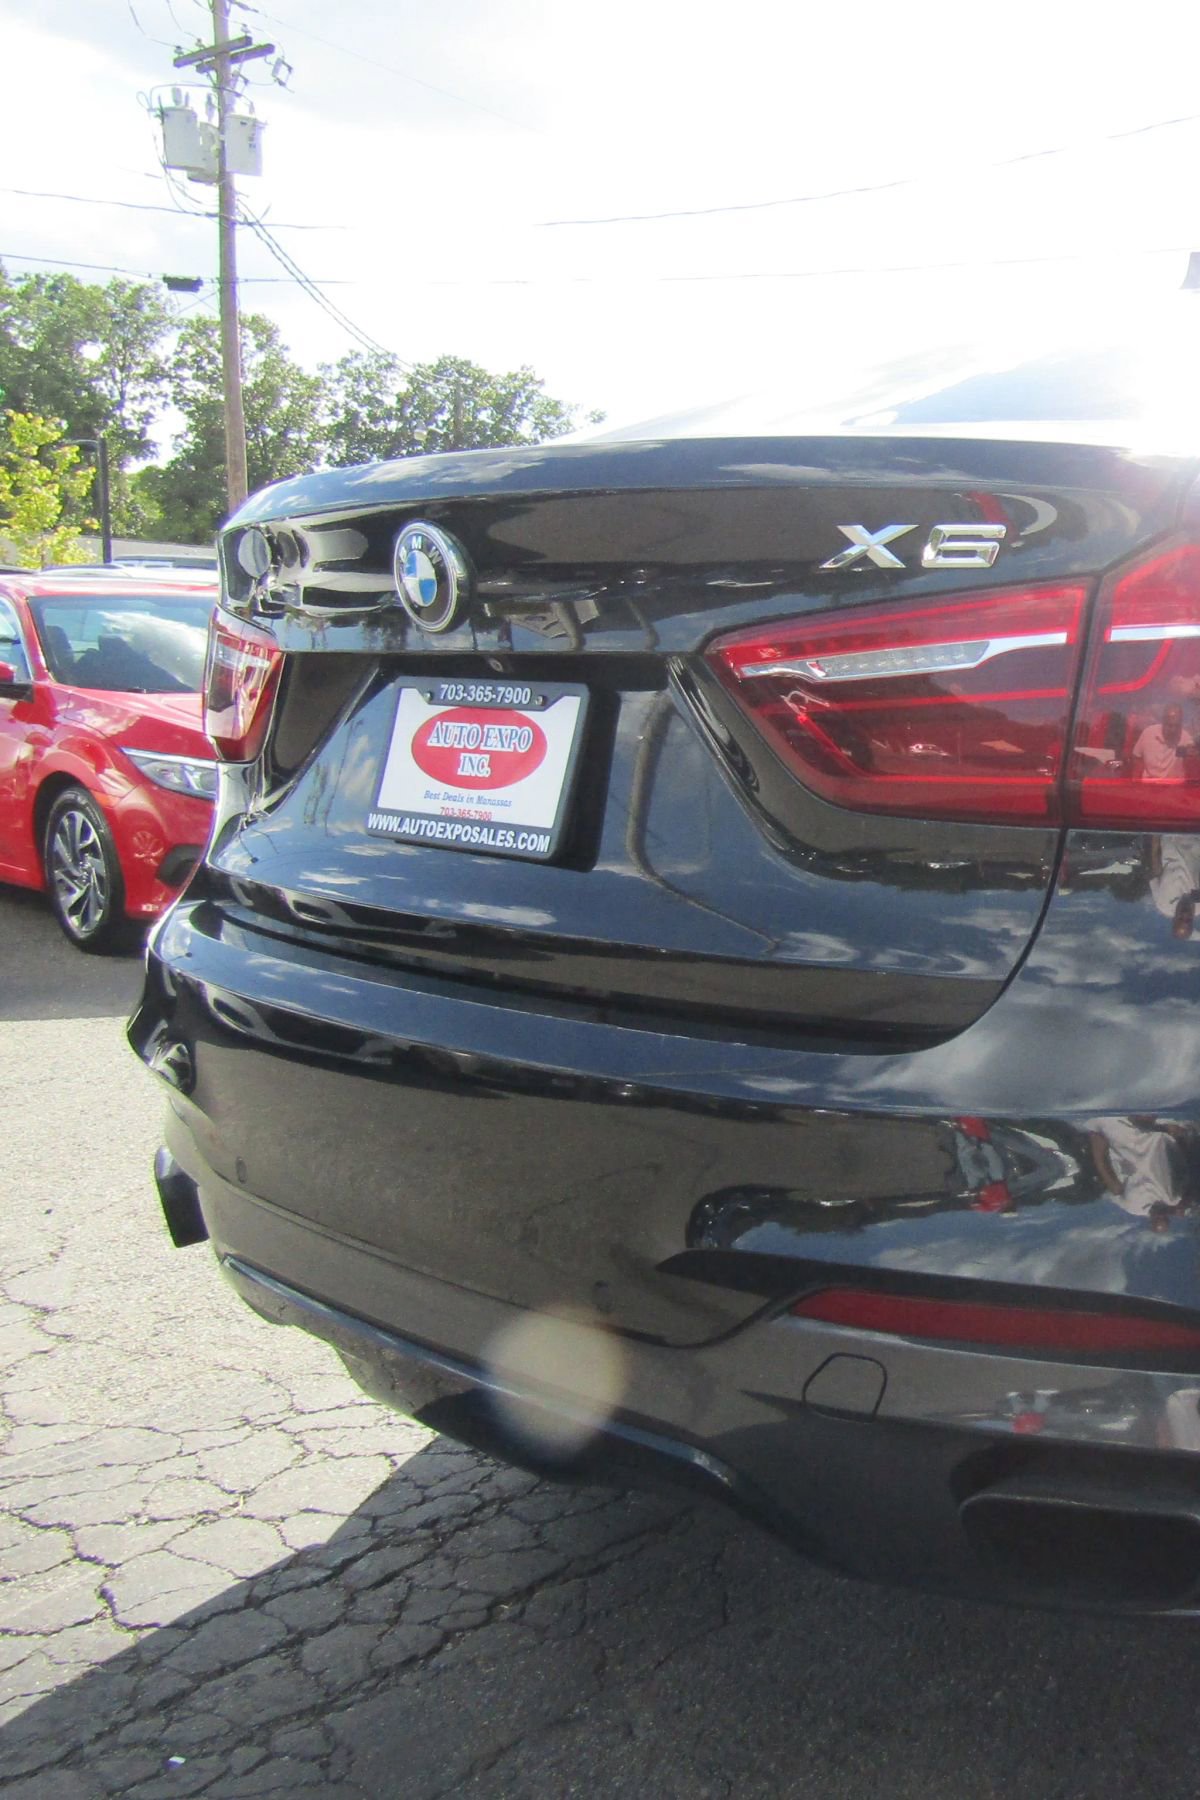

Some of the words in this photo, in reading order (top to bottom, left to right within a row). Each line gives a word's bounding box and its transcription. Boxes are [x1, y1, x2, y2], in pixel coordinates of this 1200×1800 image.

[819, 504, 1007, 568] X6
[399, 535, 442, 564] BMW
[440, 684, 532, 705] 703-365-7900
[429, 722, 480, 748] AUTO
[481, 725, 533, 752] EXPO
[458, 754, 491, 777] INC.
[424, 789, 441, 800] Best
[442, 792, 464, 803] Deals
[466, 795, 476, 804] in
[476, 795, 513, 808] Manassas
[440, 806, 493, 822] 703-365-7900
[367, 813, 551, 853] WWW.AUTOEXPOSALES.COM
